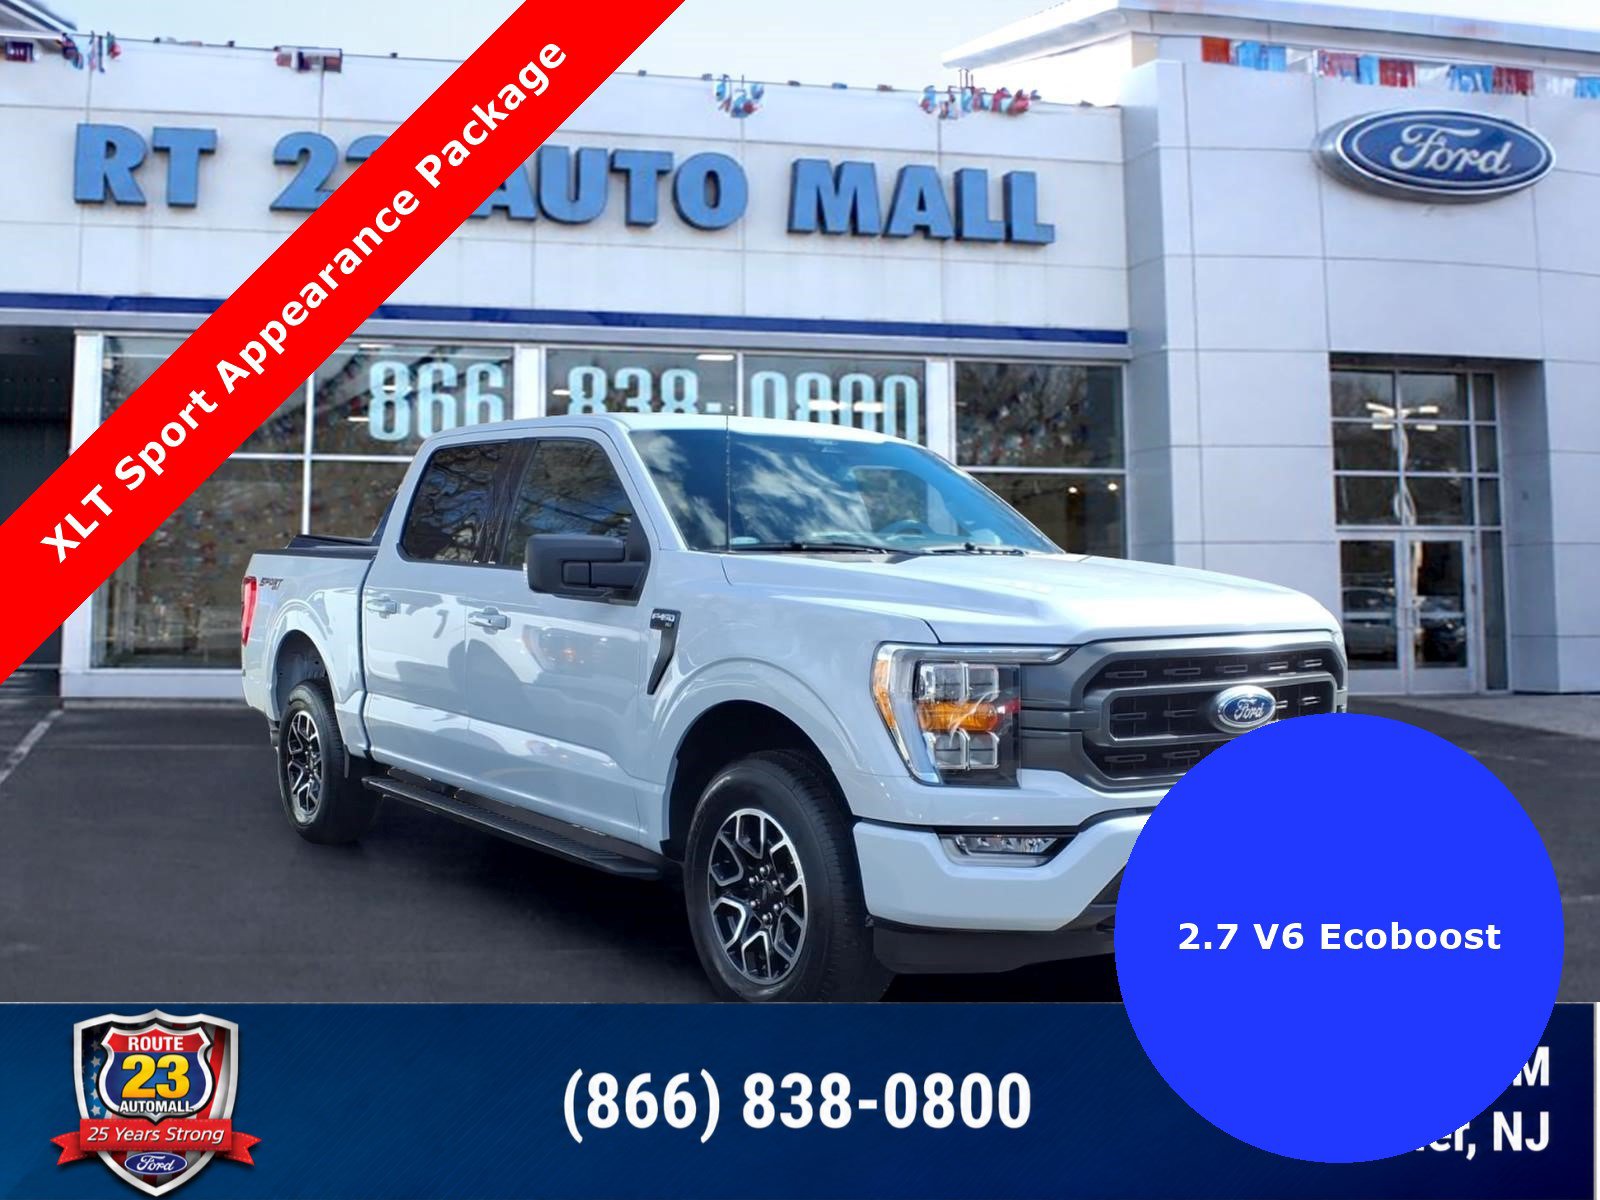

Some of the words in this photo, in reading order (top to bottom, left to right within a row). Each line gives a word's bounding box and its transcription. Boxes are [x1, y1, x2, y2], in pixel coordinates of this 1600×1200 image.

[1390, 123, 1513, 174] Ford
[74, 123, 217, 207] RT
[788, 158, 1055, 245] MALL
[369, 361, 505, 440] 866
[1234, 698, 1265, 720] Ford
